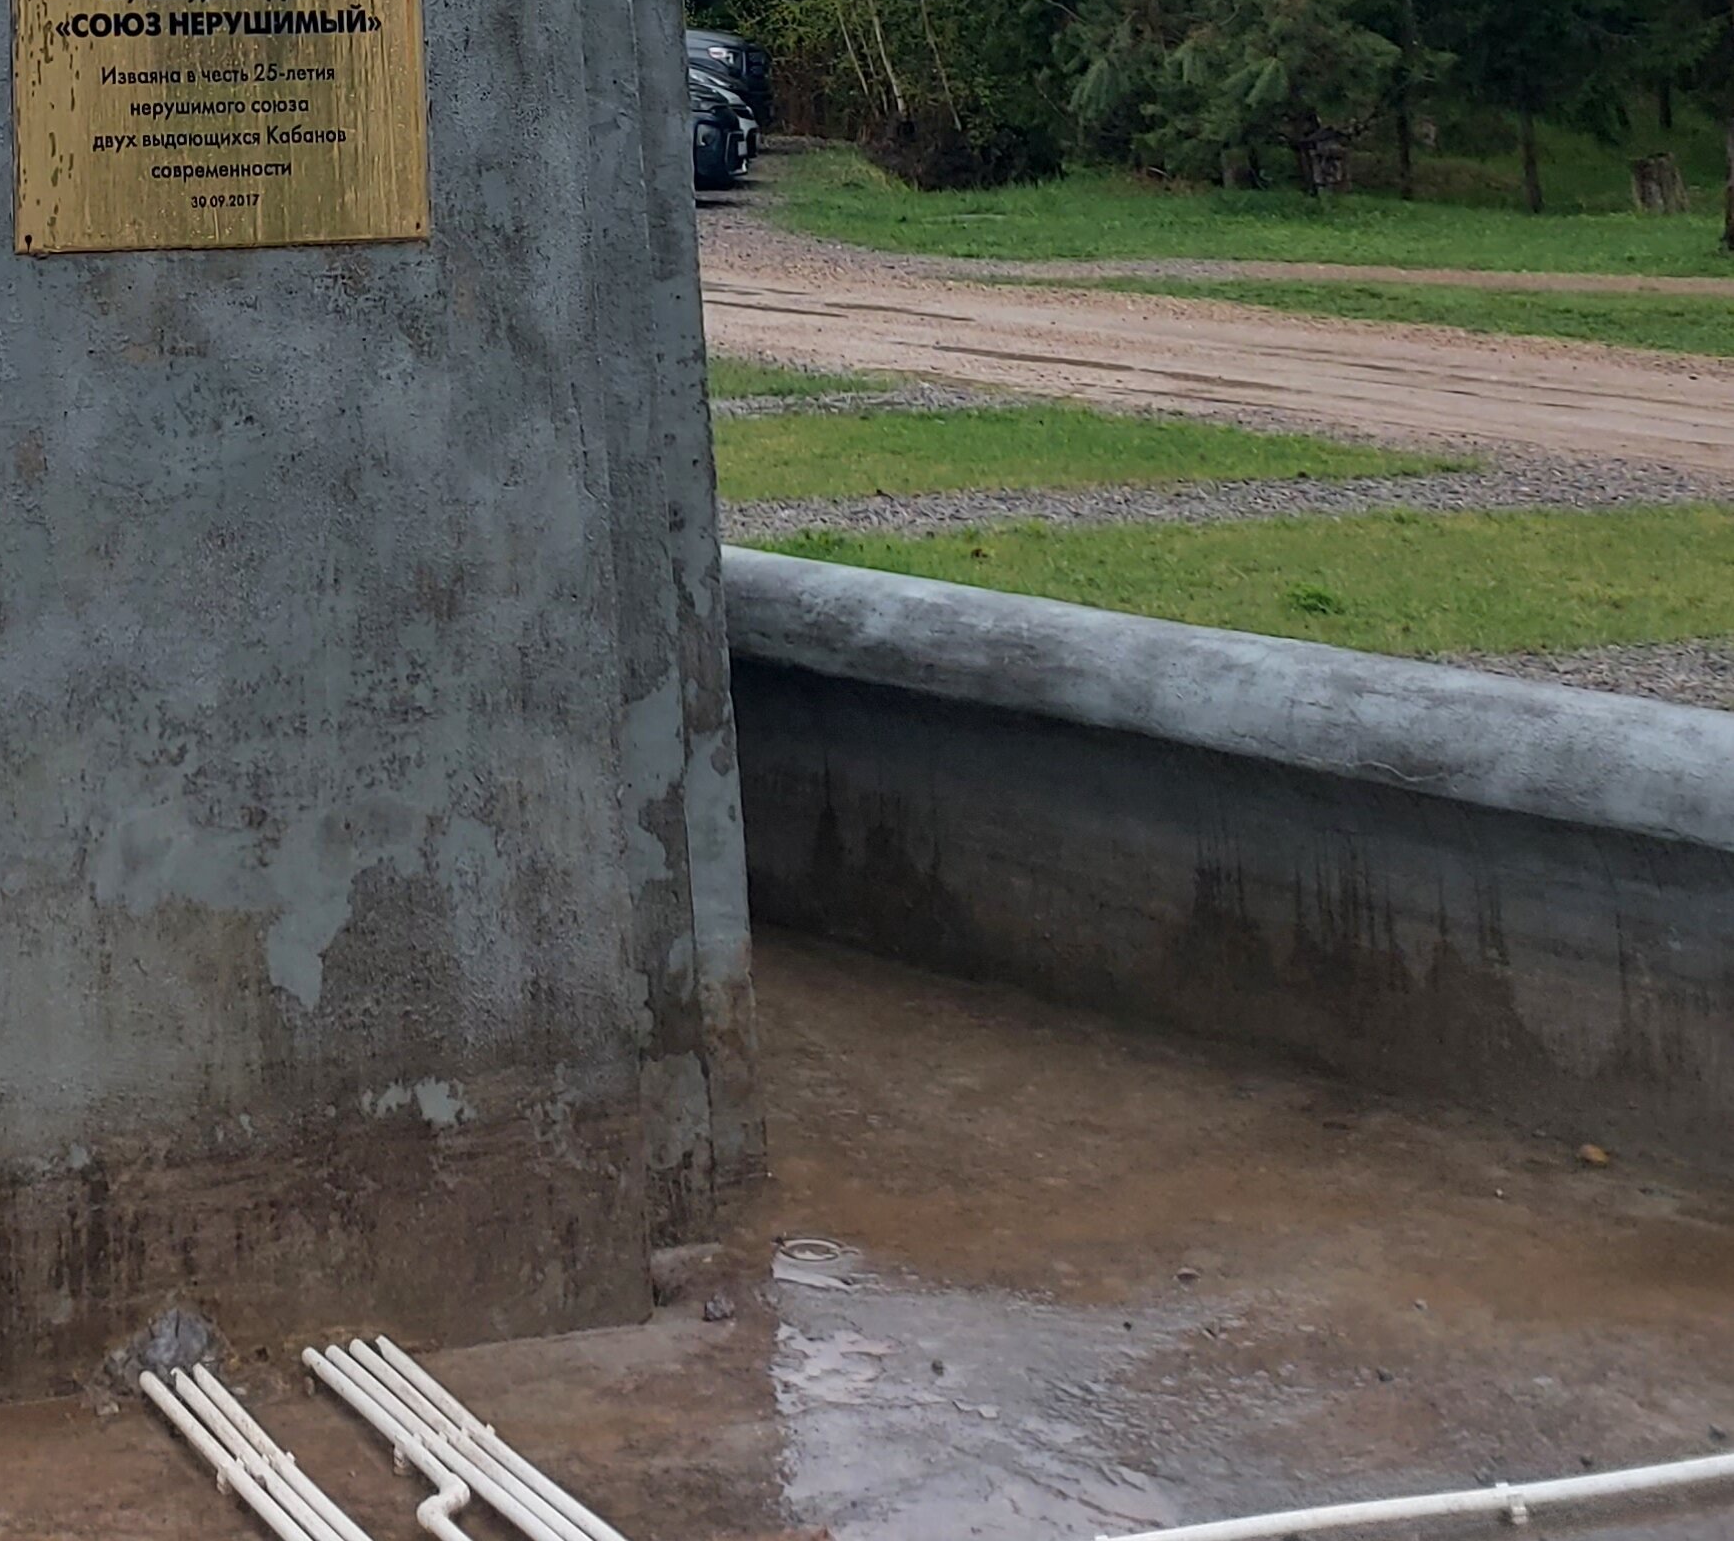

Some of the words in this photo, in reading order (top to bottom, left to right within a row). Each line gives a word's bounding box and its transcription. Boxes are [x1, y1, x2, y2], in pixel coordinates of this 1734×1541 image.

[55, 13, 162, 37] «СОЮЗ
[170, 5, 382, 36] НЕРУШИМЫЙ»
[101, 67, 181, 85] Изваяна
[186, 70, 195, 83] в
[201, 68, 249, 83] честь
[254, 65, 335, 82] 25-летия
[130, 99, 245, 117] нерушимого
[251, 98, 309, 113] союза
[93, 135, 137, 152] двух
[142, 131, 261, 151] выдающихся
[267, 127, 346, 146] Кабанов
[151, 162, 292, 182] современности
